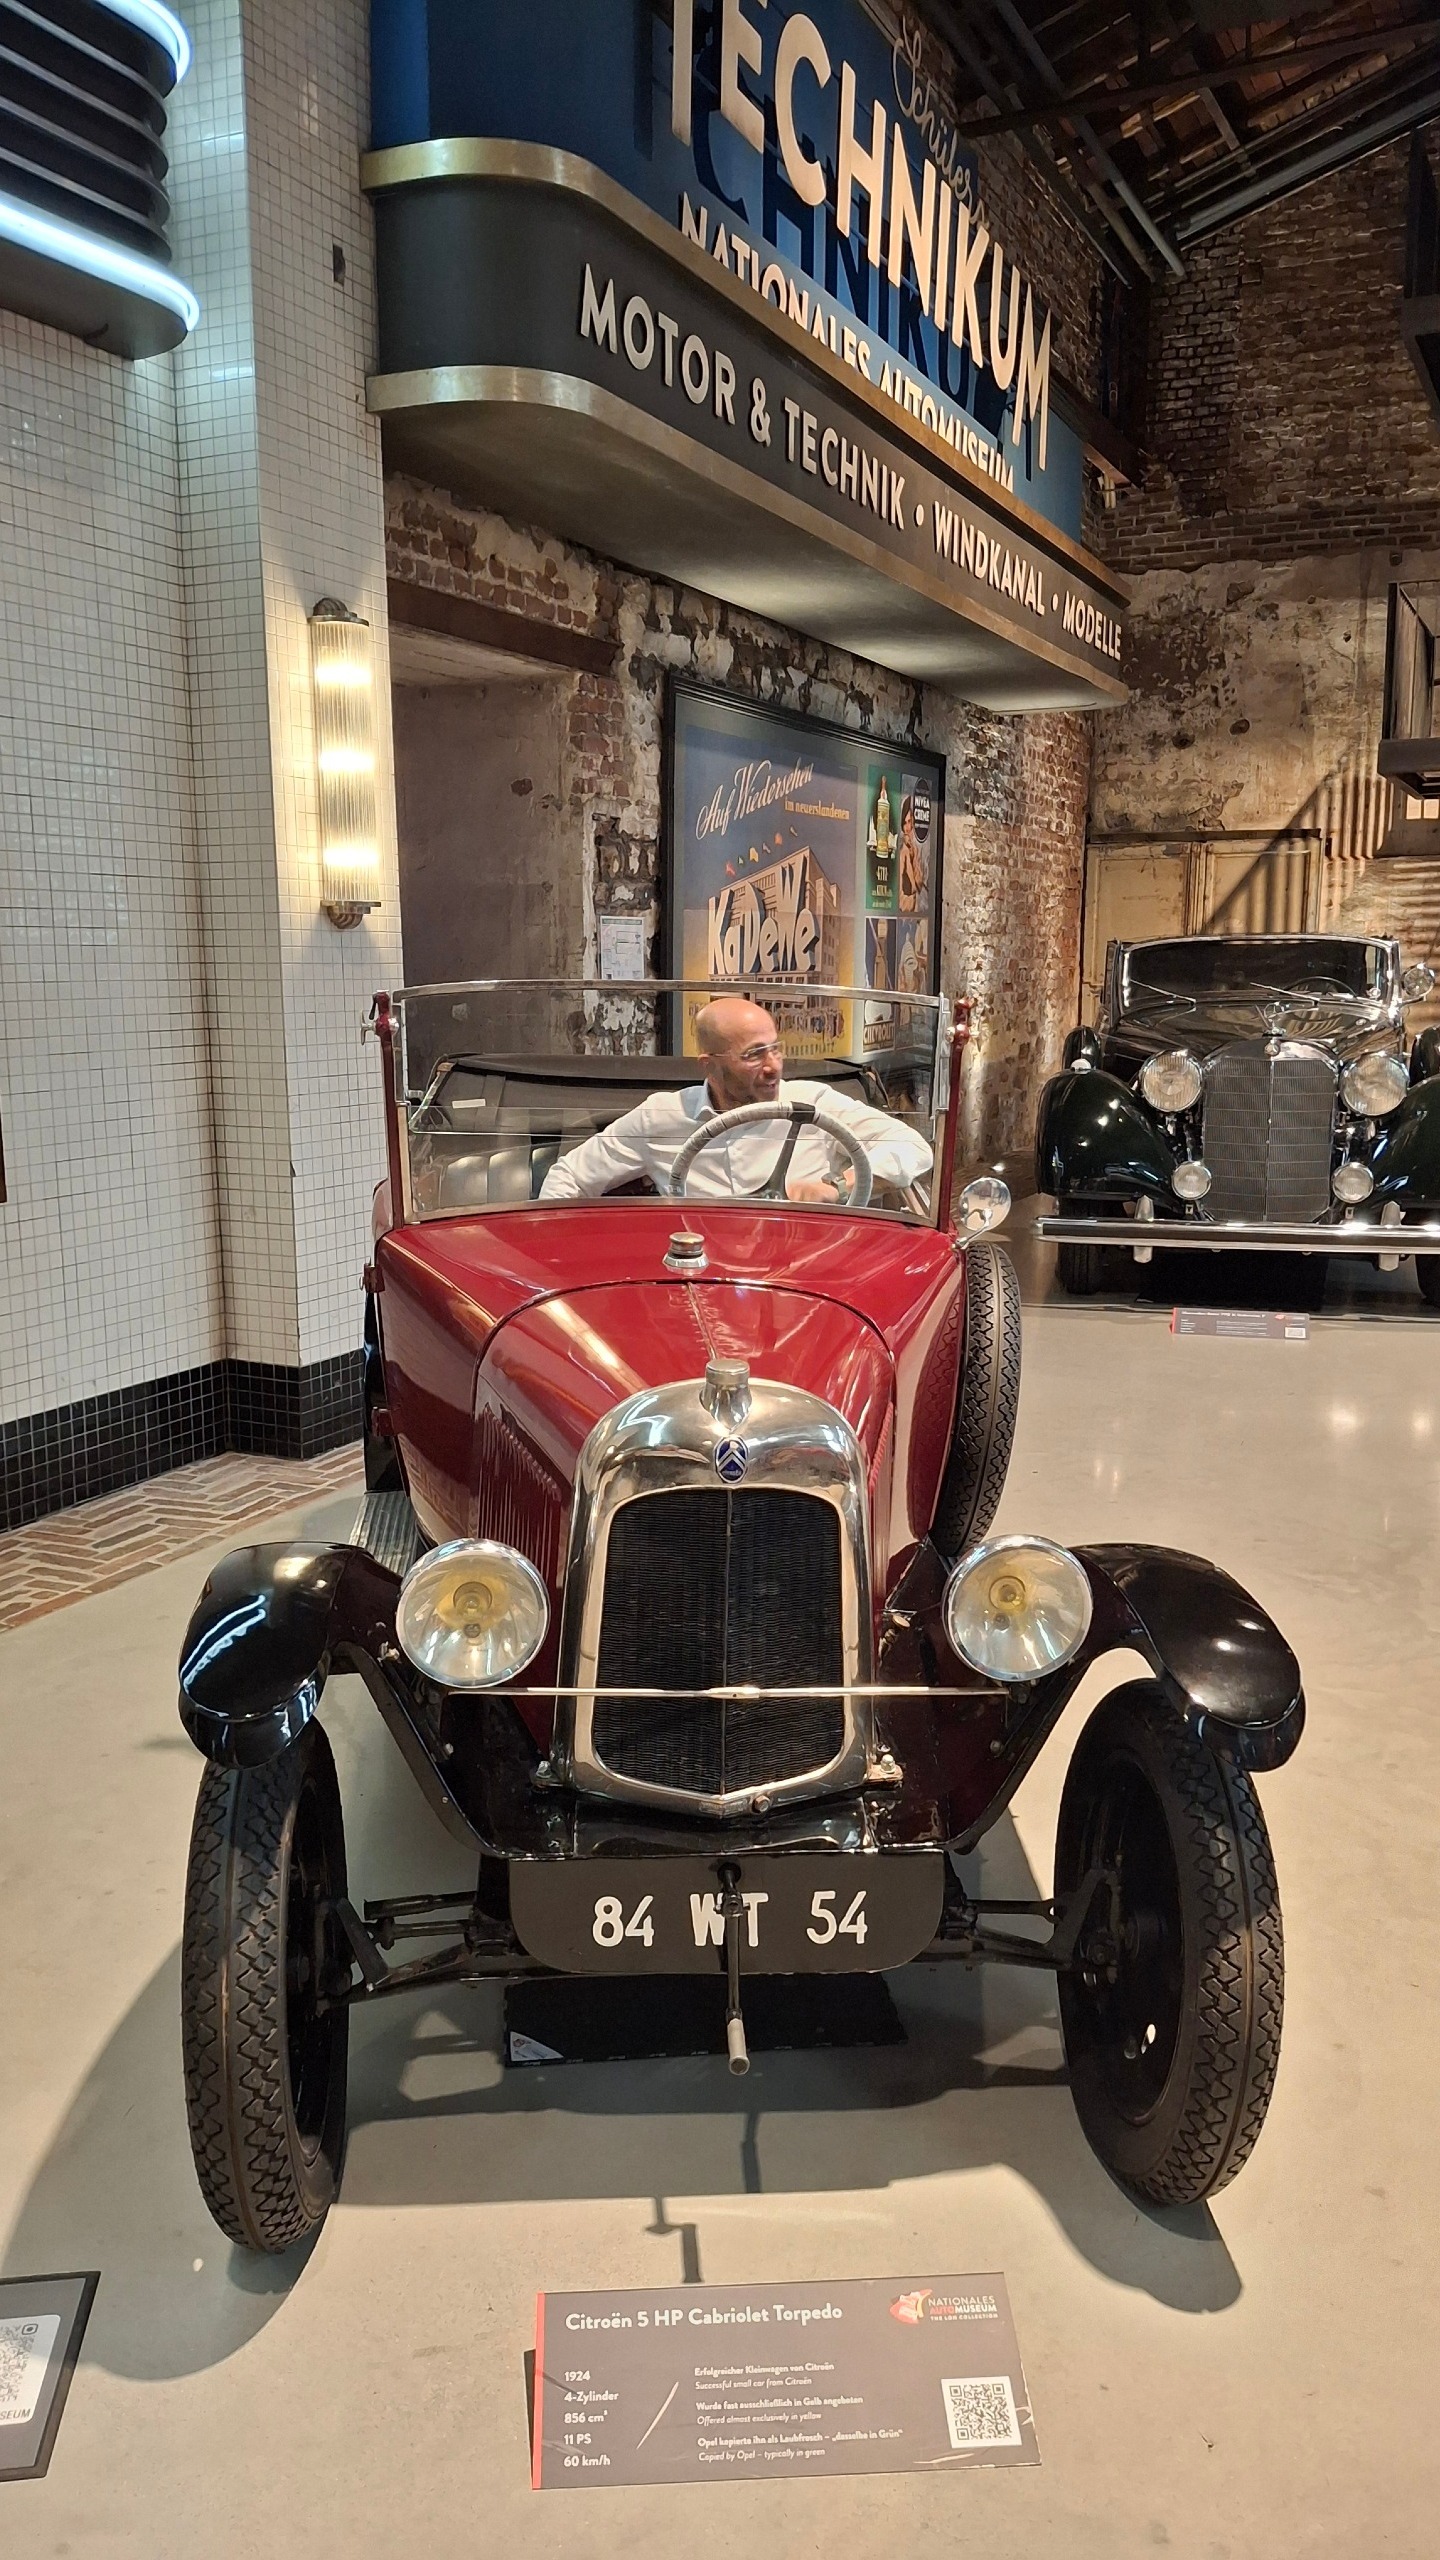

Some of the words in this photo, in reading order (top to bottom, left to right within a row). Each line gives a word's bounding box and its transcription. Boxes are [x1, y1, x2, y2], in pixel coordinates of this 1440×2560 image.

[681, 191, 871, 381] NATIONALES
[880, 359, 1014, 494] AUTOMUSEUM
[580, 262, 736, 425] MOTOR
[750, 377, 771, 447] &
[784, 396, 906, 530] TECHNIK
[934, 500, 1045, 616] WINDKANAL
[1062, 590, 1122, 661] MODELLE
[695, 784, 736, 840] Auf
[733, 756, 815, 821] Wiedersehen
[914, 795, 930, 809] NIVEA
[708, 854, 819, 975] KaDeWe
[592, 1895, 654, 1947] 84
[689, 1892, 769, 1948] WT
[806, 1890, 868, 1945] 54
[928, 2295, 995, 2307] NATIONALES
[565, 2312, 633, 2331] Citroën
[637, 2310, 649, 2328] 5
[654, 2309, 684, 2327] HP
[688, 2306, 770, 2325] Cabriolet
[772, 2302, 843, 2326] Torpedo
[930, 2304, 998, 2315] AUTOMUSEUM
[564, 2370, 591, 2382] 1924
[694, 2366, 744, 2378] Erfolgreicher
[745, 2365, 789, 2376] Kleinwagen
[804, 2362, 835, 2371] Citroën
[695, 2380, 732, 2391] Successful
[733, 2379, 752, 2388] small
[766, 2378, 783, 2389] from
[784, 2376, 812, 2386] Citroën
[564, 2390, 619, 2405] 4-Zylinder
[695, 2401, 722, 2411] Wurde
[723, 2400, 738, 2410] fast
[794, 2398, 802, 2407] in
[803, 2396, 822, 2406] Gelb
[823, 2395, 864, 2408] angeboten
[564, 2412, 586, 2424] 856
[697, 2415, 725, 2427] Offered
[726, 2414, 750, 2424] almost
[752, 2412, 790, 2423] exclusively
[790, 2412, 798, 2420] in
[799, 2411, 822, 2423] yellow
[564, 2434, 574, 2445] 11
[576, 2433, 592, 2445] PS
[697, 2437, 718, 2449] Opel
[719, 2436, 752, 2449] kopierte
[752, 2435, 766, 2444] ihn
[767, 2434, 779, 2443] als
[779, 2432, 823, 2443] Laubfrosch
[869, 2430, 878, 2439] in
[563, 2455, 580, 2467] 60
[581, 2454, 611, 2467] km/h
[698, 2451, 725, 2463] Copied
[725, 2451, 735, 2462] by
[737, 2449, 756, 2462] Opel
[764, 2448, 795, 2460] typically
[796, 2448, 804, 2457] in
[805, 2448, 826, 2459] green
